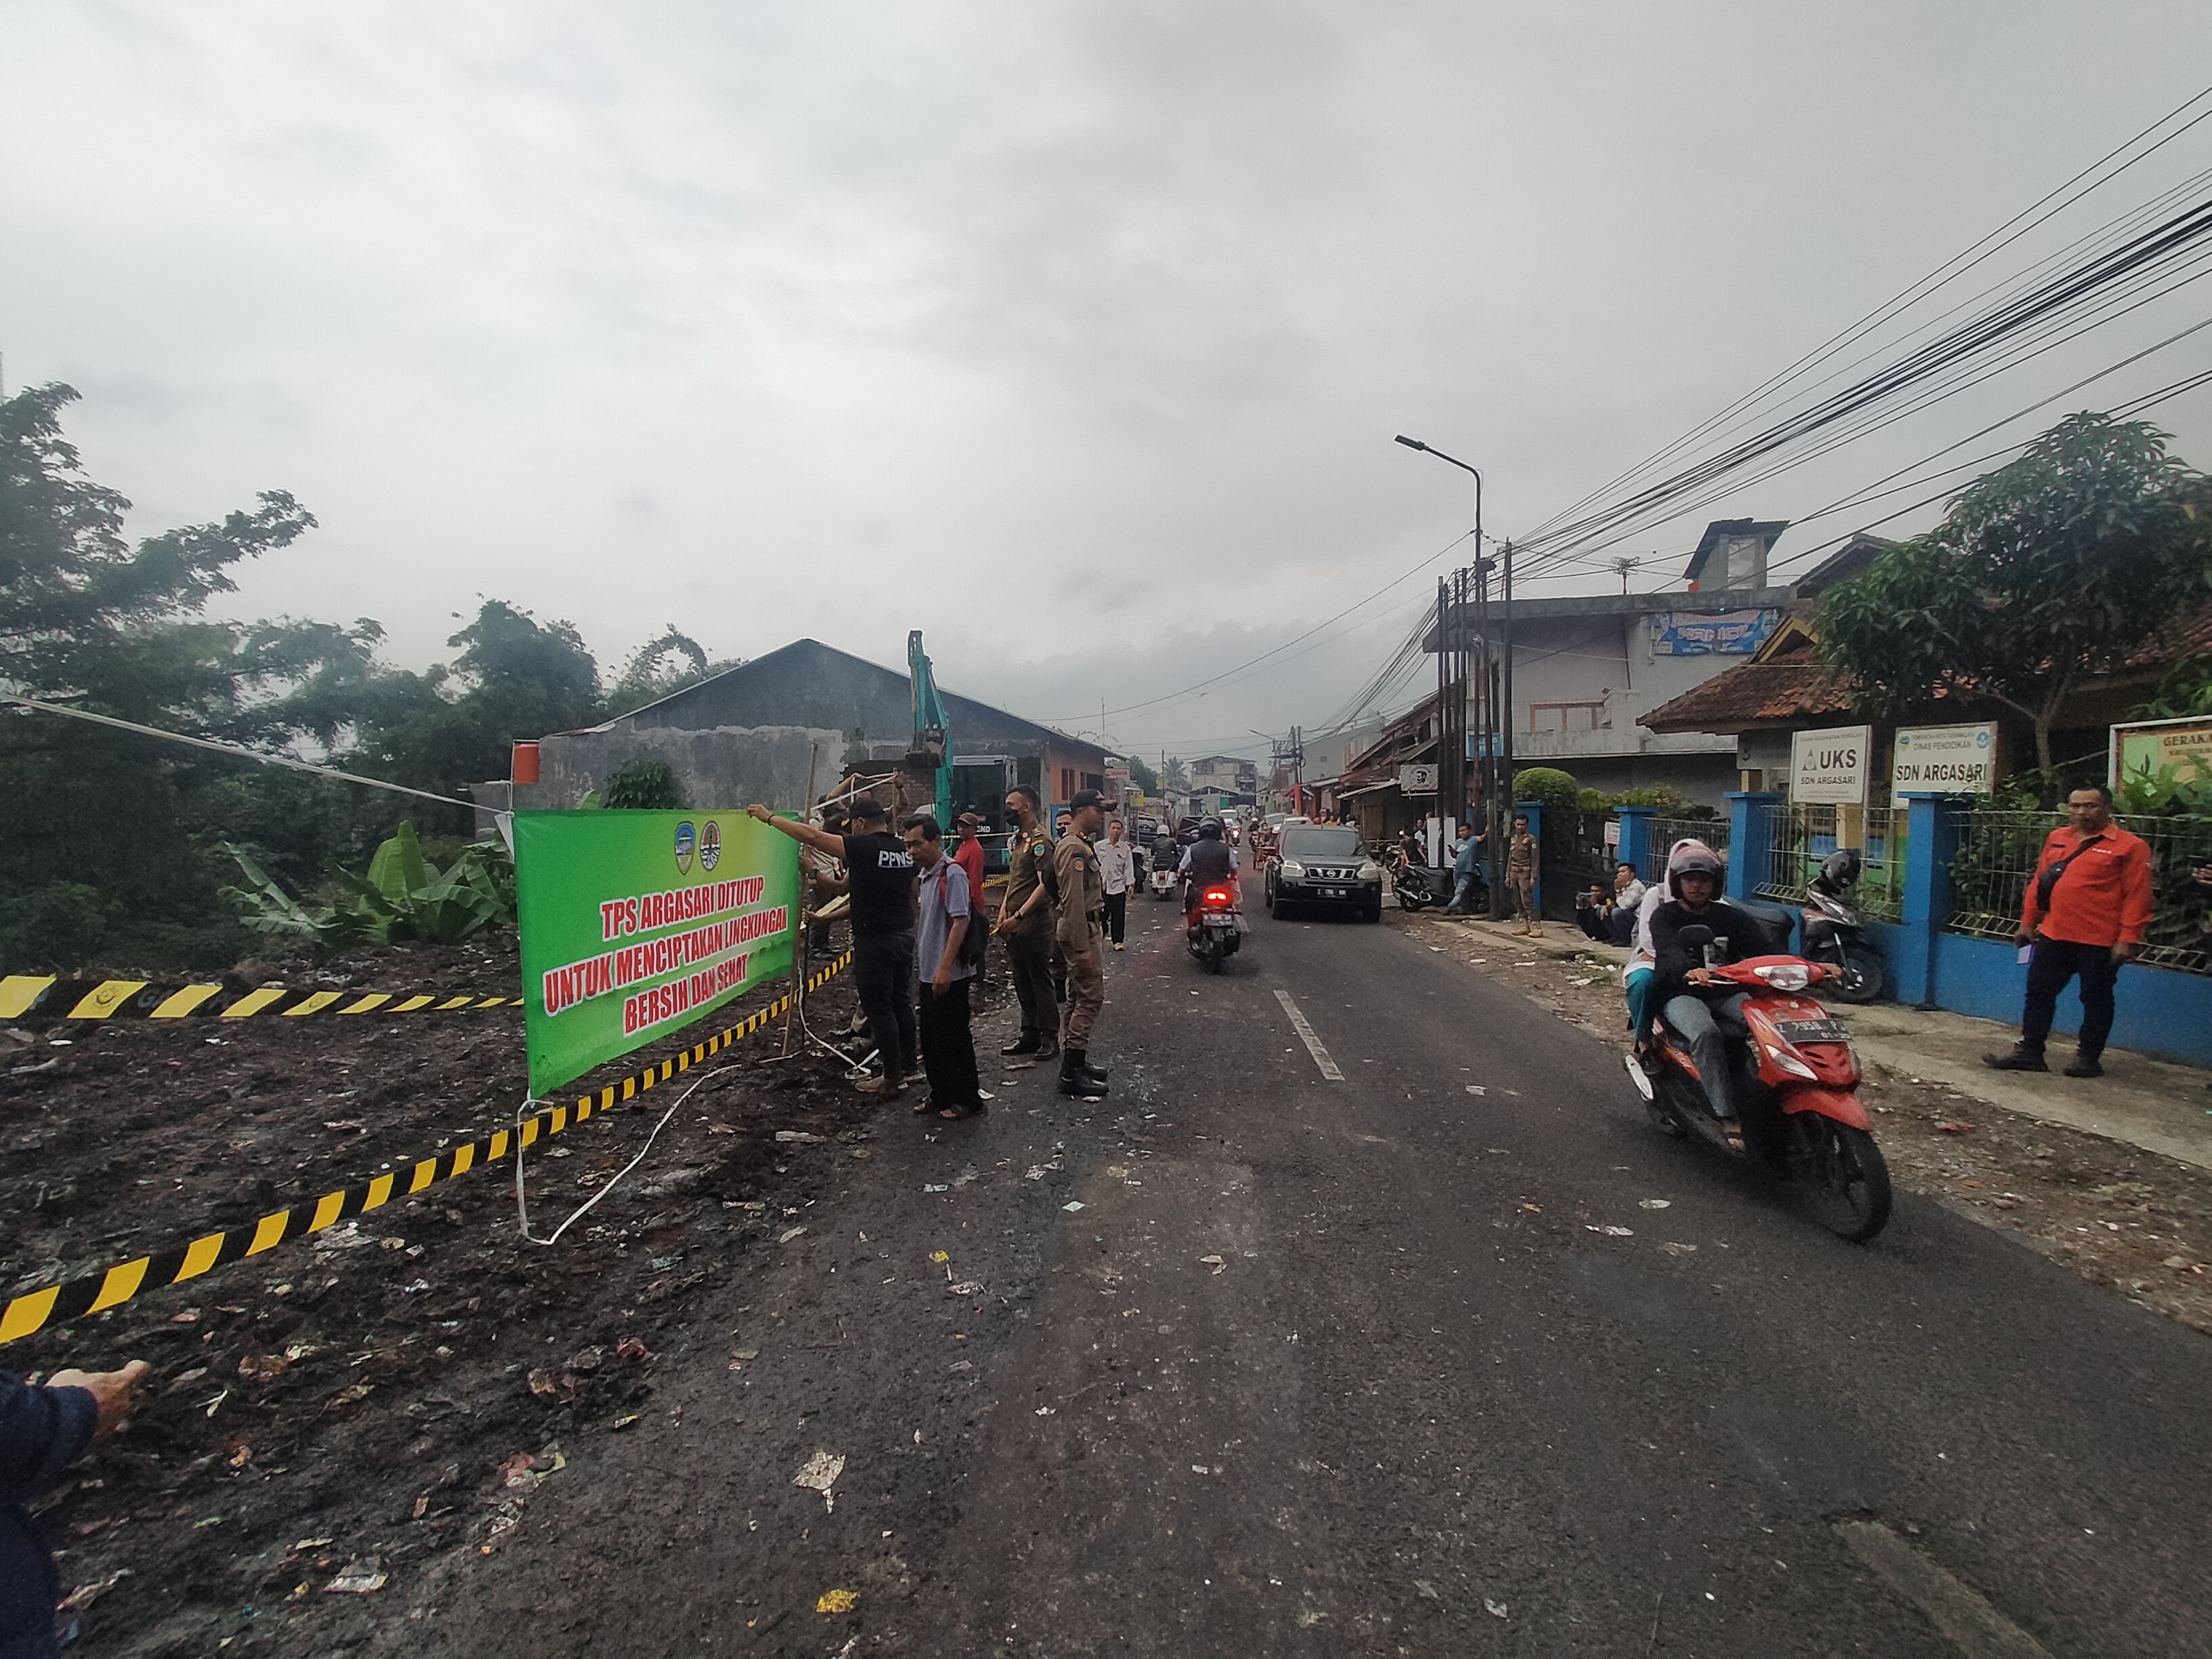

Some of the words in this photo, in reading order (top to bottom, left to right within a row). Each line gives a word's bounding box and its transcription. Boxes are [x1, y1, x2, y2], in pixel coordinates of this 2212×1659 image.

[1820, 749, 1857, 769] UKS
[1801, 777, 1816, 785] SDN
[1817, 775, 1856, 785] ARGASARI
[1897, 764, 1920, 781] SDN
[1922, 763, 1988, 781] ARGASARI
[878, 850, 914, 867] PPNS
[600, 896, 638, 942] TPS
[638, 884, 716, 933] ARGASARI
[716, 875, 764, 912] DITUTUP
[543, 951, 613, 1017] UNTUK
[614, 921, 723, 990] MENCIPTAKAN
[724, 905, 788, 949] LINGKUNGAN
[623, 976, 689, 1038] BERSIH
[689, 966, 716, 1009] DAN
[716, 953, 749, 994] SEHAT
